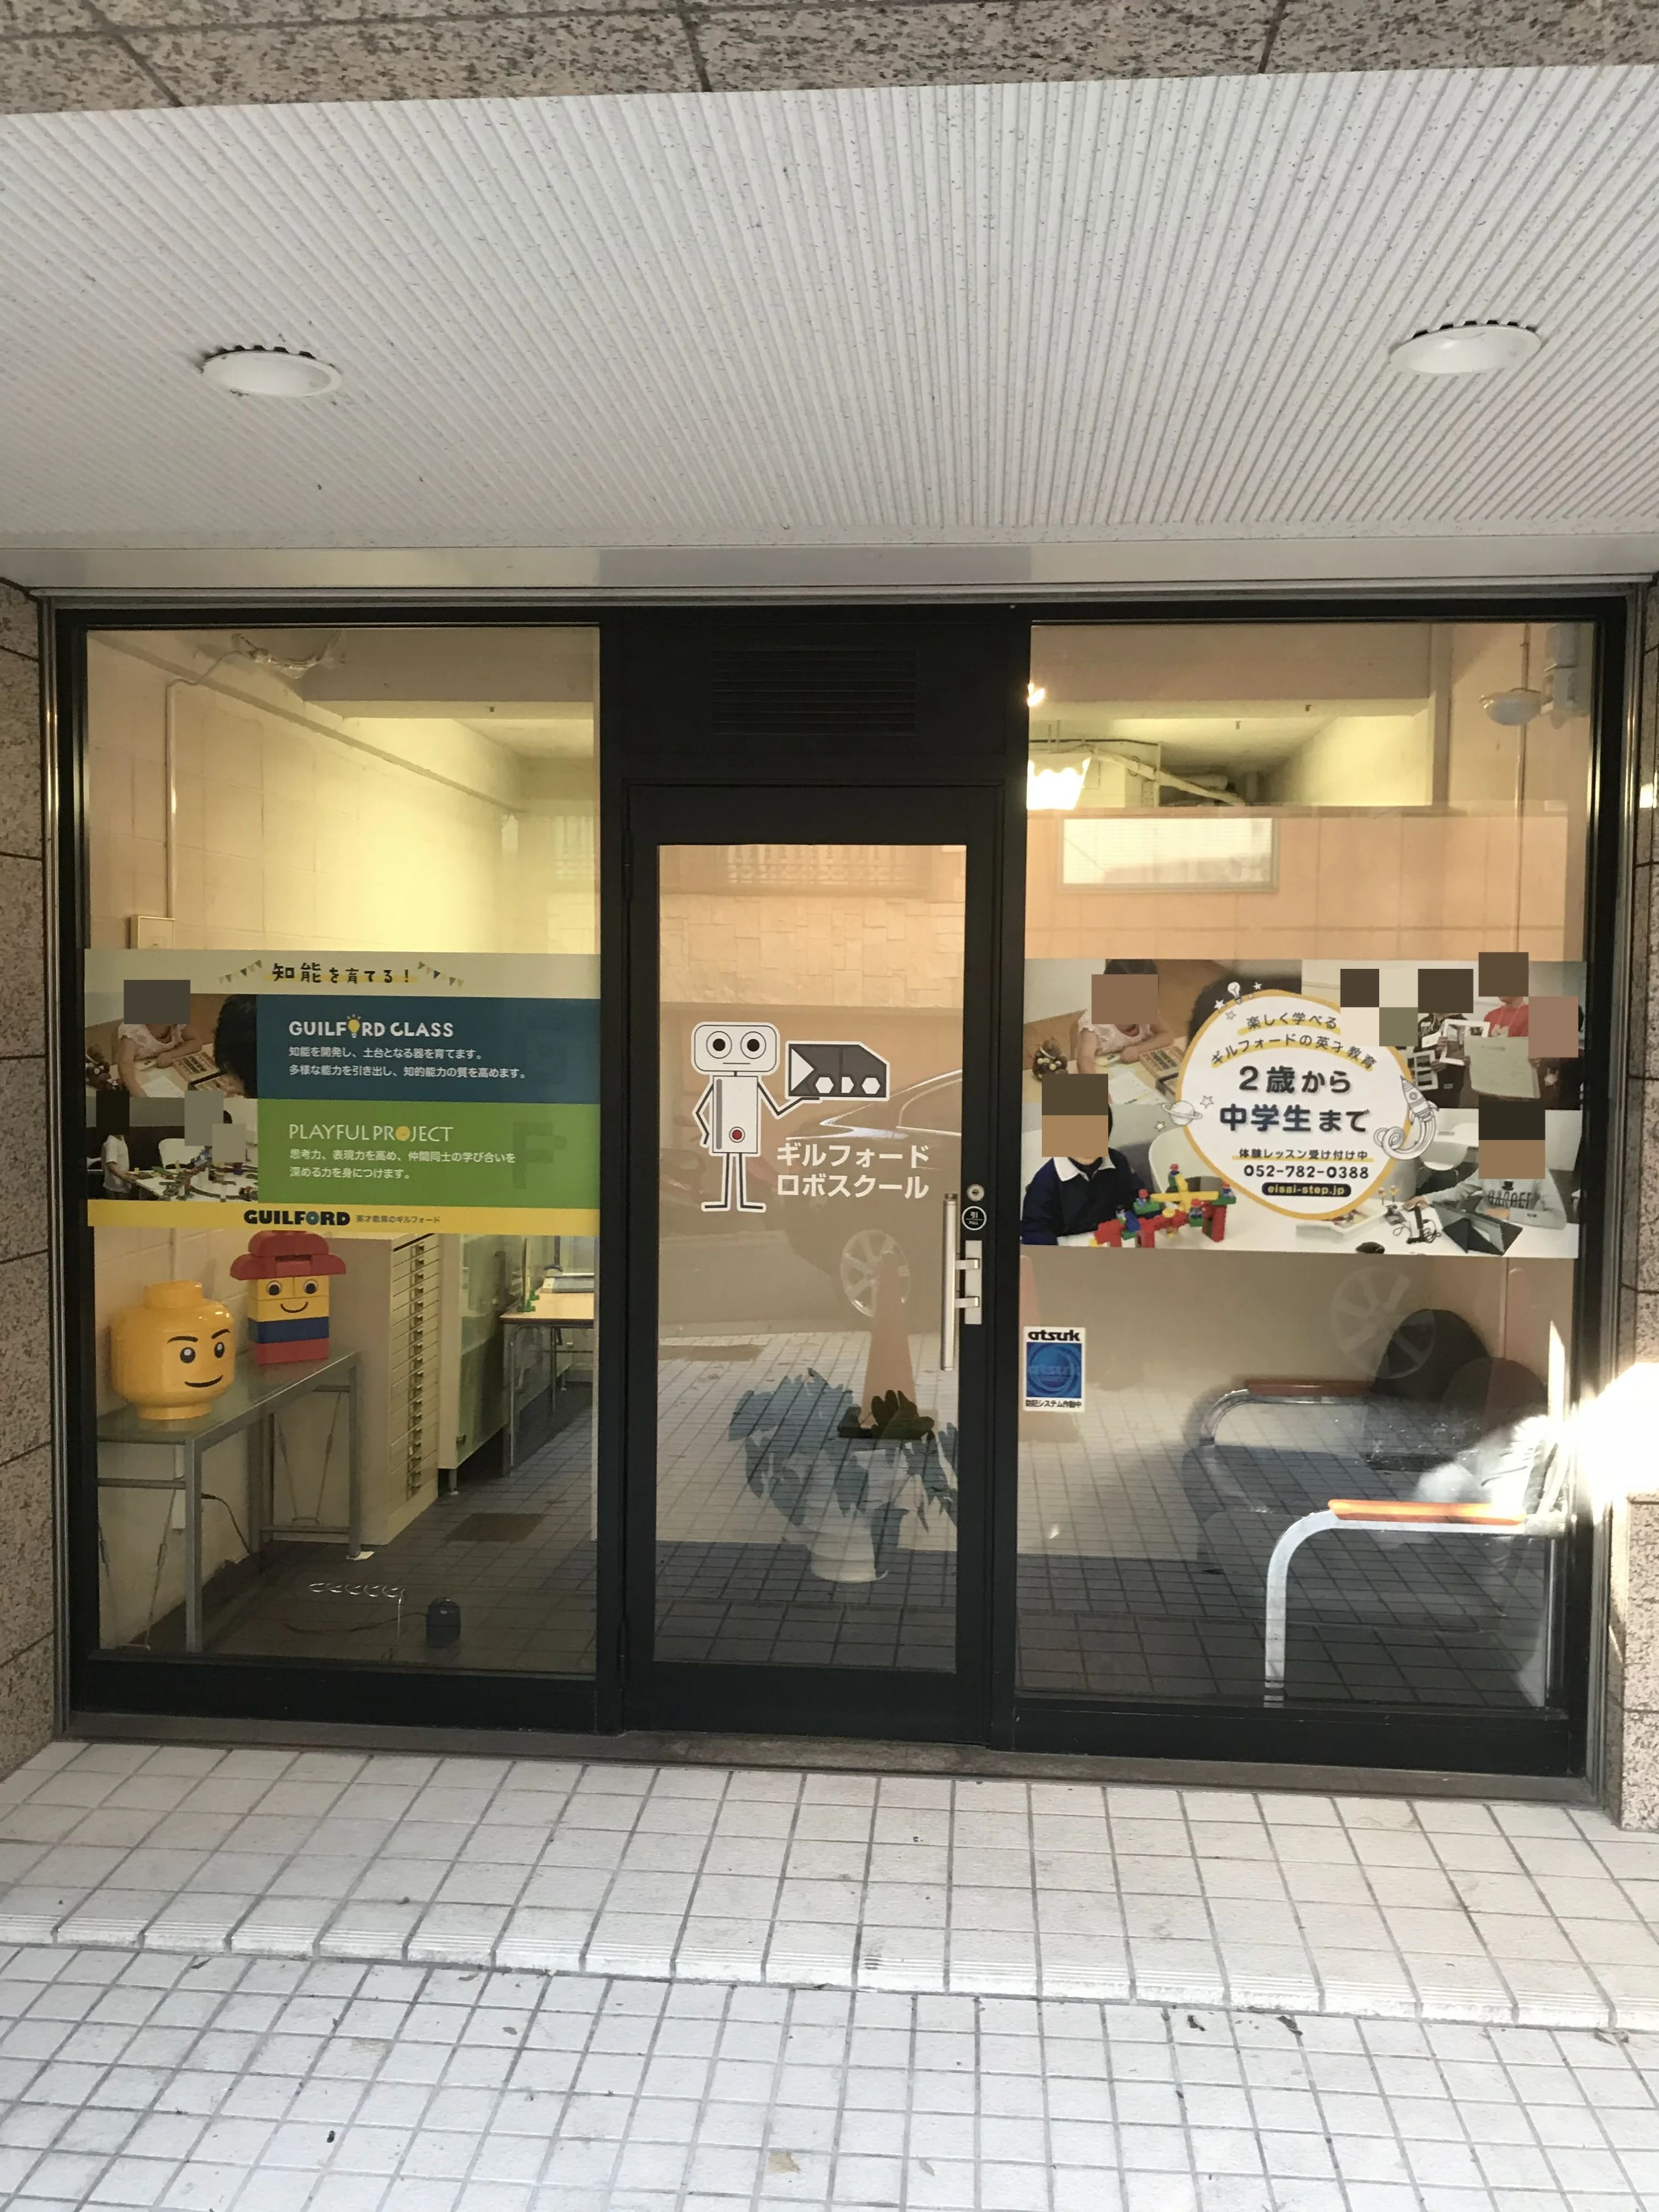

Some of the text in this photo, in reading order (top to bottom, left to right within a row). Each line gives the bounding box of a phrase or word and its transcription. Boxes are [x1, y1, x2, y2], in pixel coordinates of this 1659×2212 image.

[1246, 1011, 1337, 1030] 楽しく学べる
[390, 1022, 453, 1037] CLASS
[1239, 1066, 1351, 1093] 2歳から
[1220, 1103, 1370, 1132] 中学生まで
[289, 1124, 369, 1140] PLAYFUL
[777, 1142, 930, 1169] ギルフォード
[1239, 1148, 1368, 1160] 体験レッスン受け付け中
[289, 1167, 410, 1180] 深める力を身につけます。
[1244, 1165, 1369, 1179] 052-782-0388
[778, 1173, 930, 1199] ロボスクール
[1267, 1183, 1345, 1196] eisai-step.jp
[243, 1209, 351, 1226] GUILFORD
